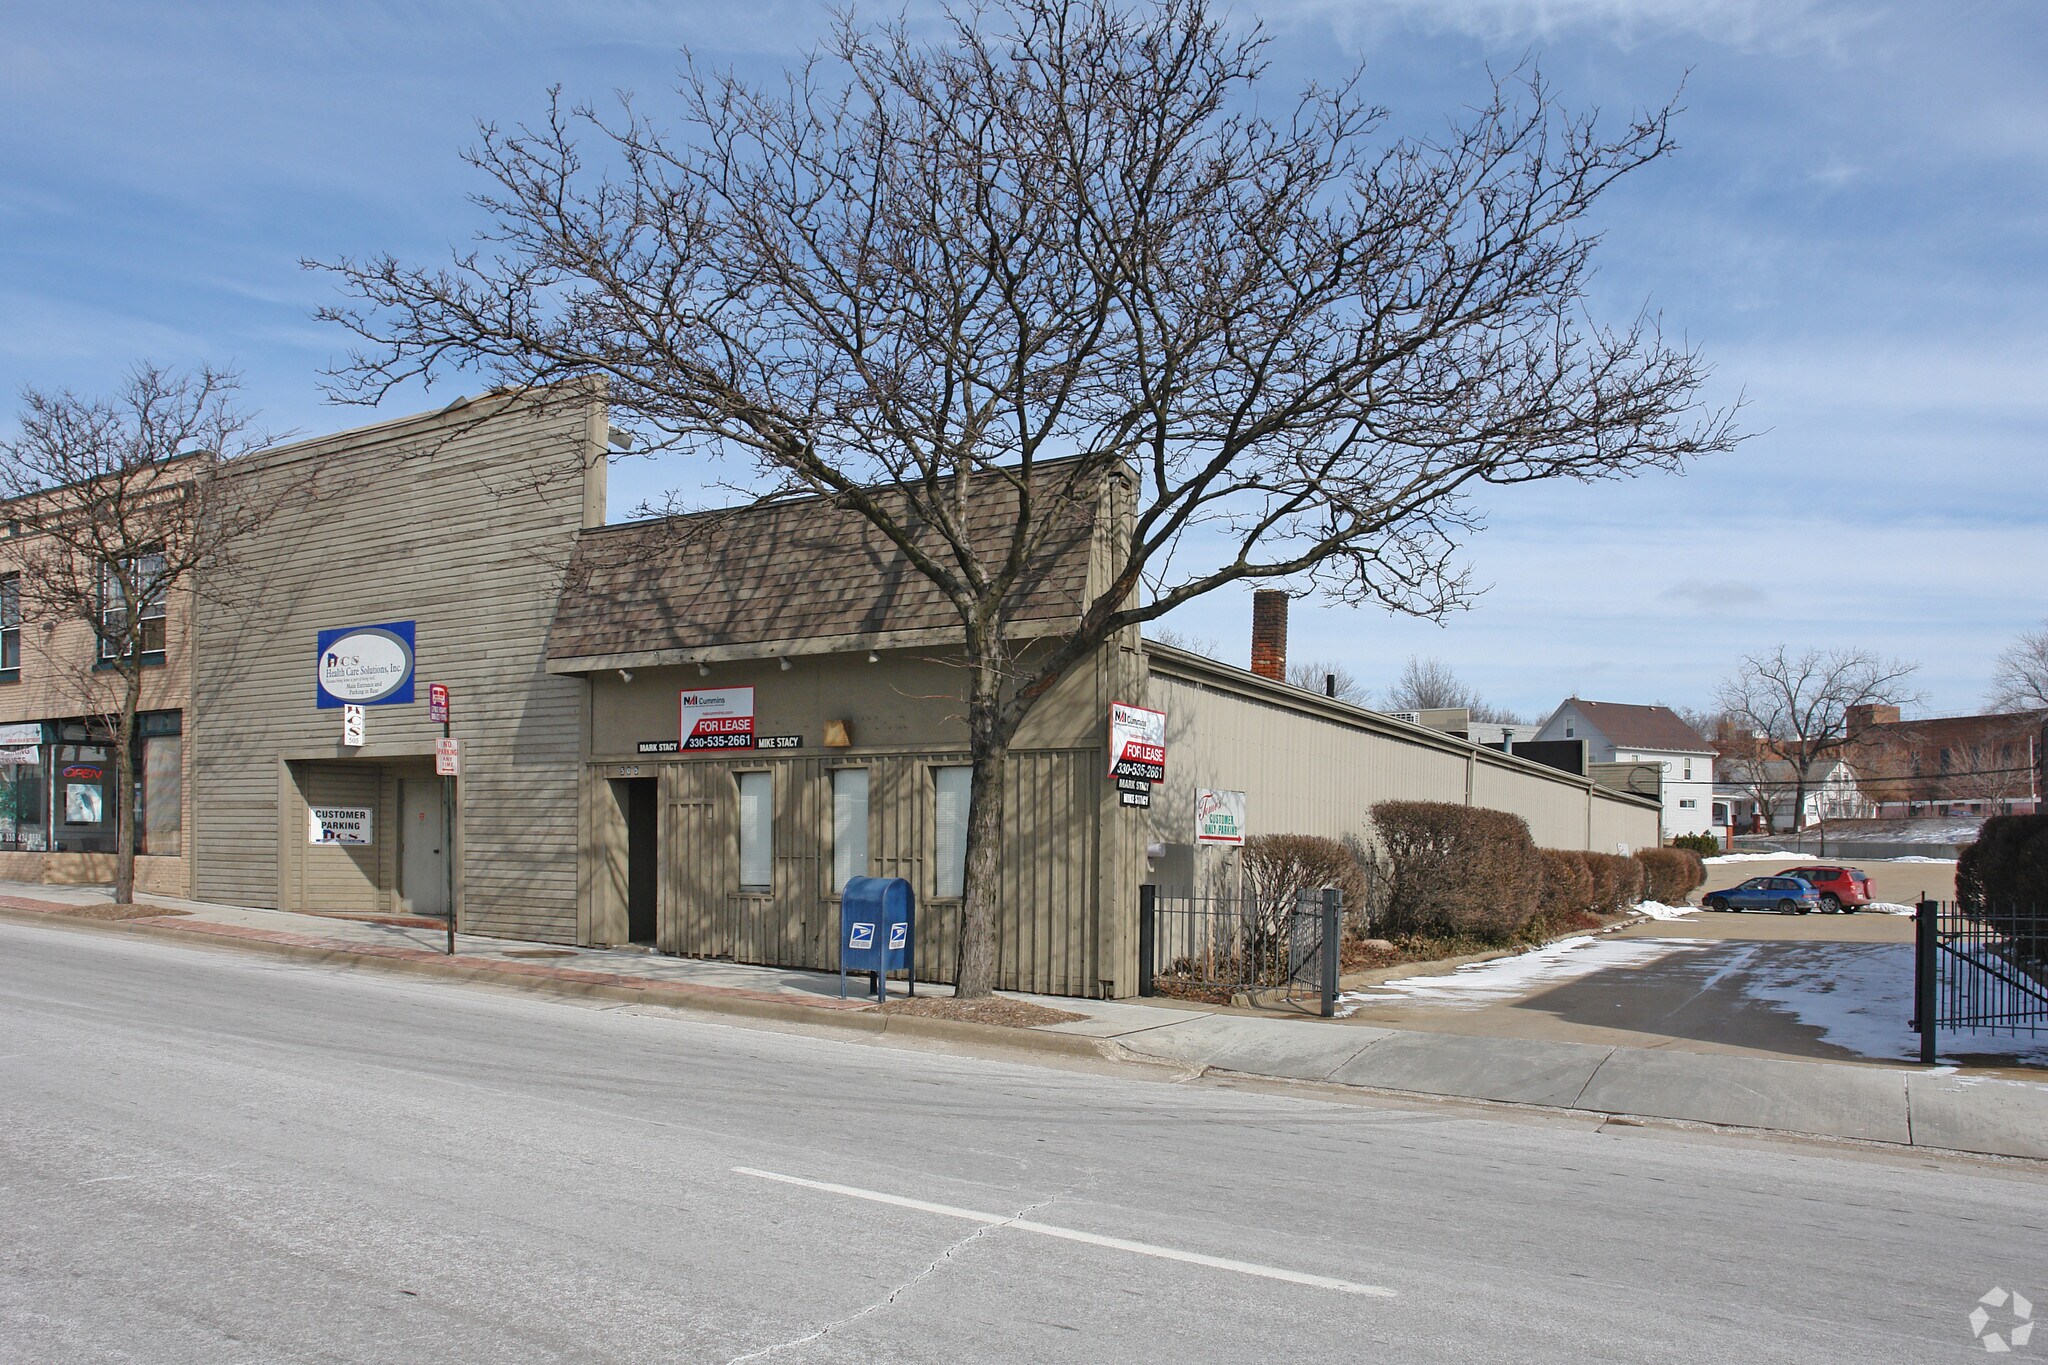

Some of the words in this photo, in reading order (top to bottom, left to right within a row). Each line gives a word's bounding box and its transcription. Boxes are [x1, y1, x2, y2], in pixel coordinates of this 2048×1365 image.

[326, 667, 345, 678] Health
[346, 666, 360, 676] Care
[684, 694, 698, 706] NAI
[699, 696, 725, 705] Cummins
[1115, 710, 1127, 724] NAI
[699, 721, 719, 732] FOR
[720, 719, 751, 731] LEASE
[443, 740, 452, 748] NO
[639, 743, 657, 752] MARK
[658, 742, 678, 751] STACY
[689, 734, 751, 748] 330-535-2661
[758, 738, 775, 748] MIKE
[776, 736, 799, 747] STACY
[1127, 744, 1142, 759] FOR
[1142, 747, 1163, 762] LEASE
[63, 768, 103, 779] OPEN
[1117, 762, 1163, 779] 330-535-2661
[1118, 778, 1135, 790] MARK
[1136, 781, 1149, 792] STACY
[1123, 793, 1134, 804] MIKE
[1135, 795, 1148, 805] STACY
[315, 810, 366, 819] CUSTOMER
[1210, 814, 1234, 824] CUSTOMER
[321, 821, 360, 830] PARKING
[1205, 824, 1216, 834] ONLY
[1218, 825, 1237, 836] PARKING
